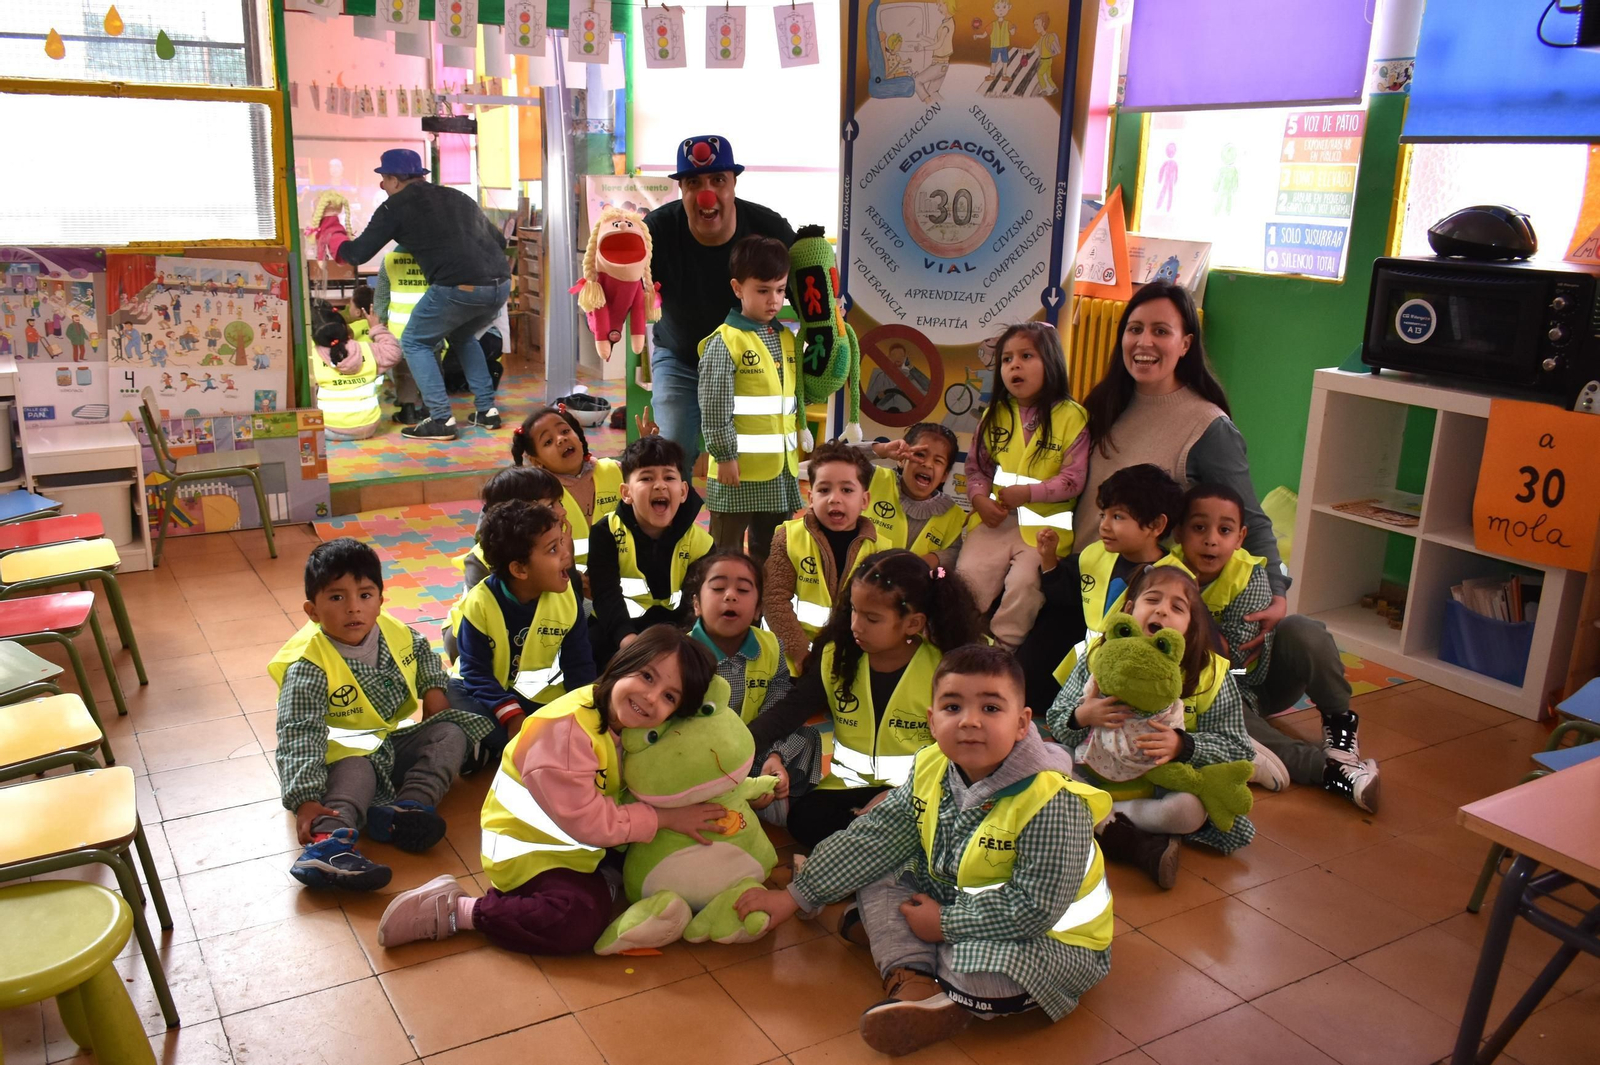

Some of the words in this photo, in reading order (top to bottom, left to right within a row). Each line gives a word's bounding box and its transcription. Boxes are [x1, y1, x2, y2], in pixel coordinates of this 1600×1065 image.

[1286, 115, 1298, 135] 5
[1303, 115, 1320, 132] VOZ
[1322, 115, 1332, 132] DE
[1335, 114, 1359, 132] PATIO
[859, 101, 942, 190] CONCIENCIACIÓN
[899, 139, 1006, 175] EDUCACIÓN
[968, 104, 1047, 195] SENSIBILIZACIÓN
[1283, 140, 1295, 160] 4
[1281, 168, 1291, 188] 3
[928, 188, 973, 226] 30
[1055, 181, 1067, 221] Educa
[1277, 193, 1288, 212] 2
[864, 205, 905, 249] RESPETO
[992, 209, 1034, 254] CIVISMO
[1268, 226, 1276, 245] 1
[1281, 227, 1301, 244] SOLO
[1304, 228, 1344, 248] SUSURRAR
[860, 227, 900, 273] VALORES
[982, 218, 1053, 289] COMPRENSIÓN
[1266, 250, 1279, 269] 0
[1281, 252, 1314, 270] SILENCIO
[1317, 256, 1336, 273] TOTAL
[923, 257, 977, 274] VIAL
[852, 257, 907, 321] TOLERANCIA
[904, 288, 987, 305] APRENDIZAJE
[978, 260, 1046, 328] SOLIDARIDAD
[916, 315, 968, 329] EMPATÍA
[124, 371, 135, 388] 4
[1538, 433, 1556, 449] a
[1514, 465, 1566, 509] 30
[1487, 513, 1571, 548] mola
[328, 706, 364, 718] OURENSE
[948, 990, 974, 1007] STORY
[975, 1001, 993, 1011] TOY
